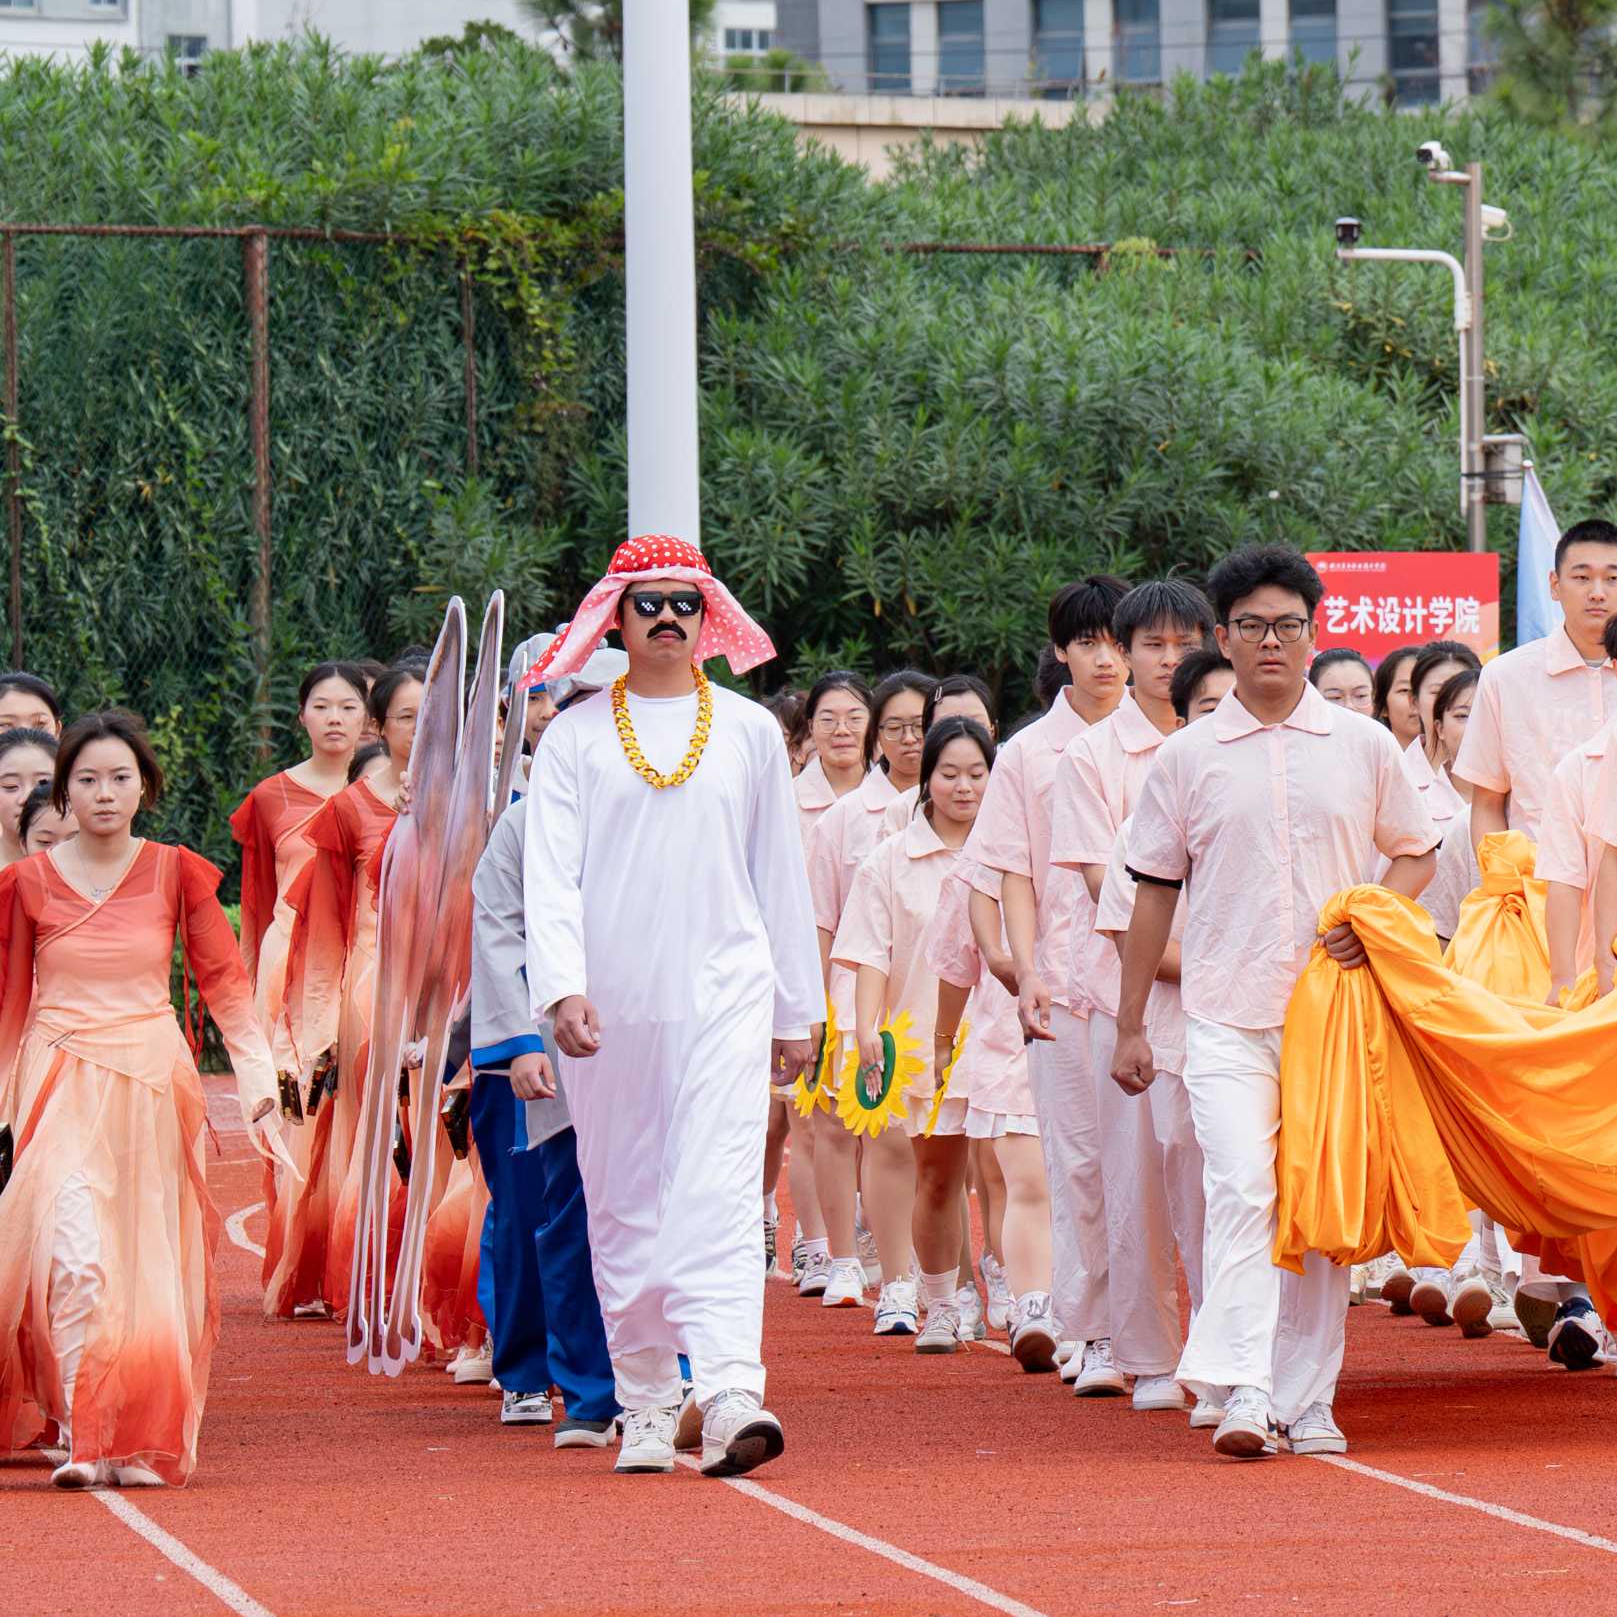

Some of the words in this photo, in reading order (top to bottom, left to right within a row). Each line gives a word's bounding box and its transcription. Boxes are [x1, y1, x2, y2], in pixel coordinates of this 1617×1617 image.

[1324, 596, 1481, 634] 艺术设计学院
